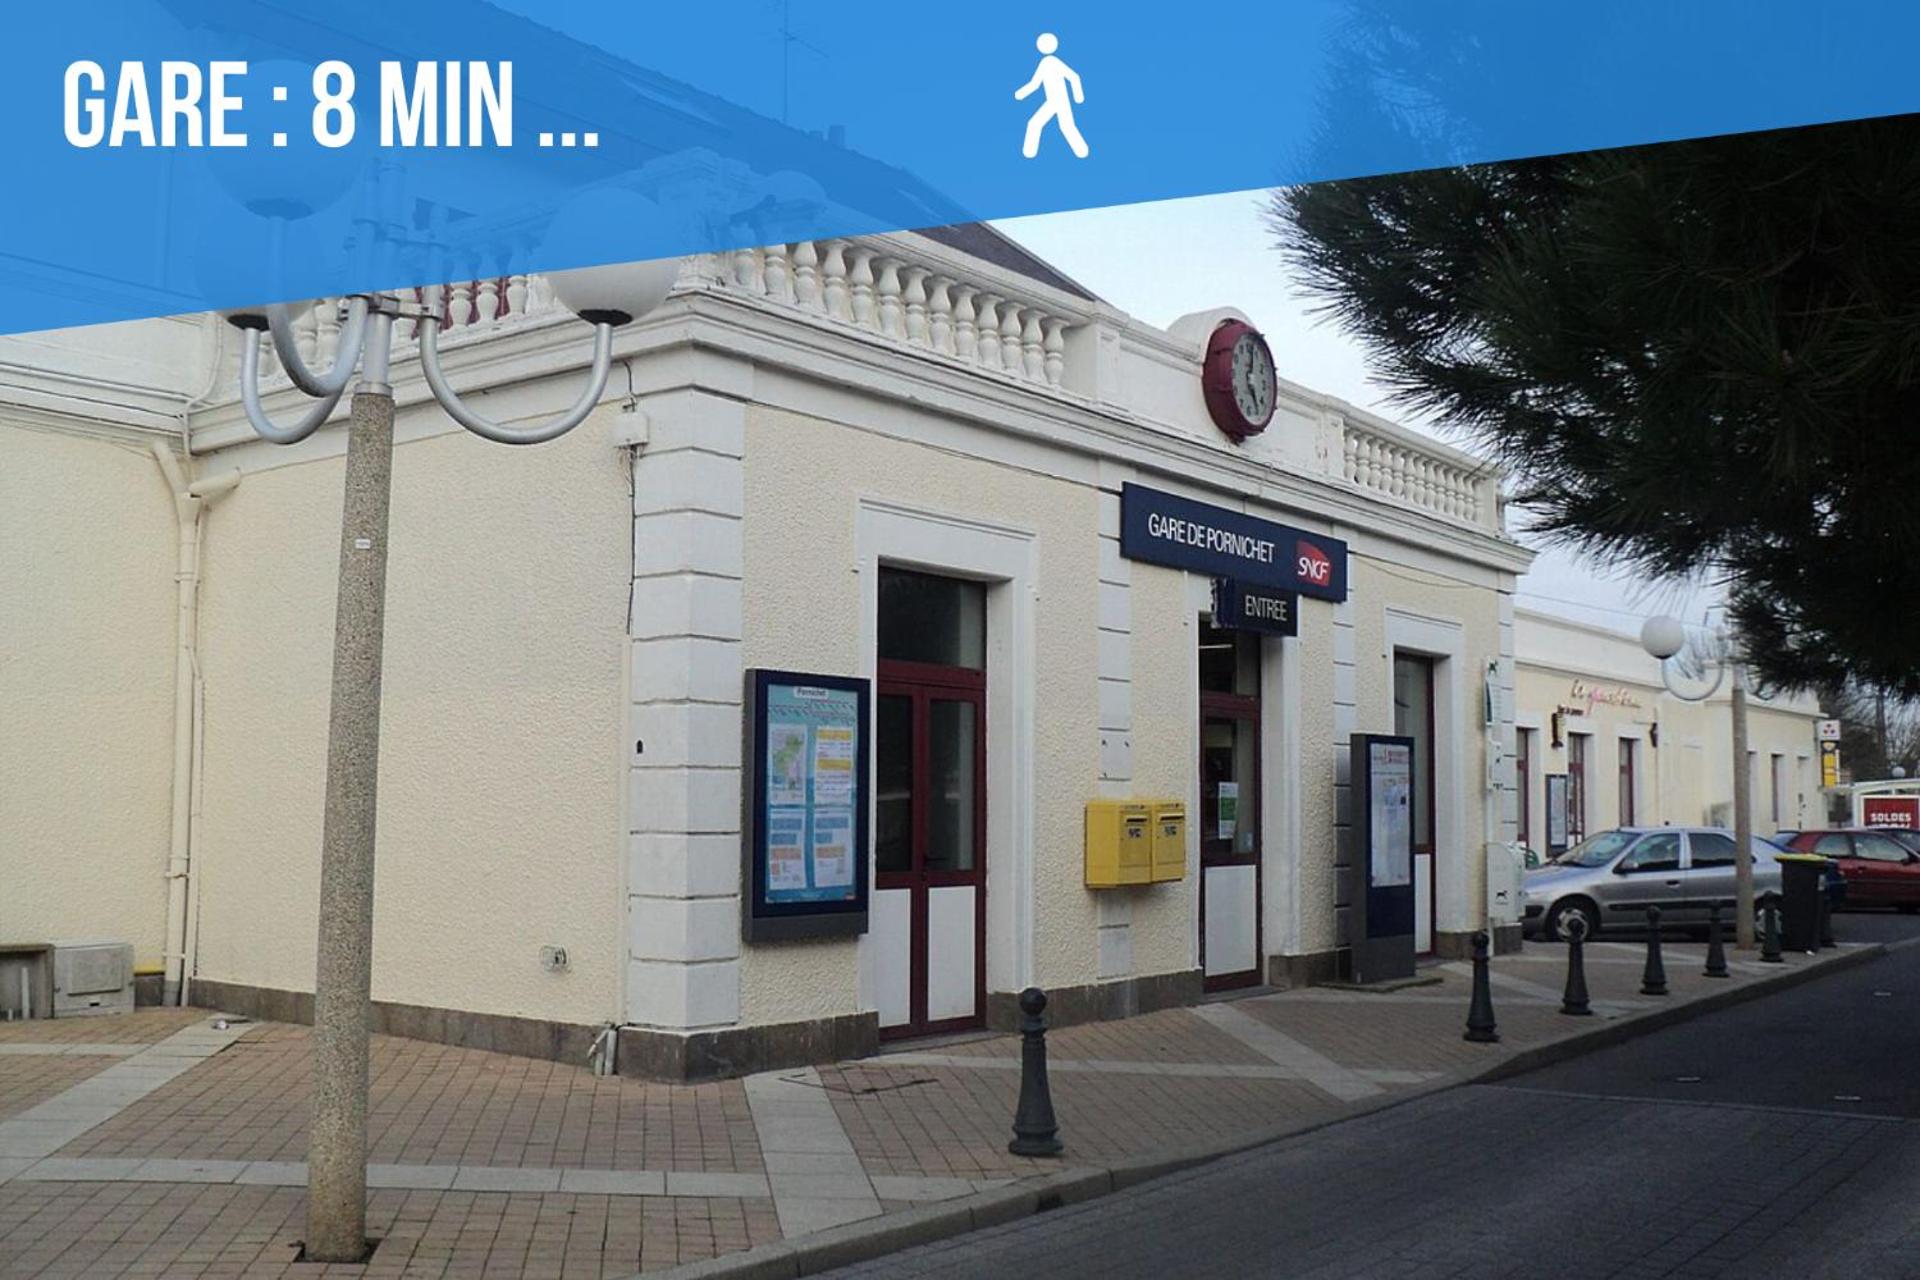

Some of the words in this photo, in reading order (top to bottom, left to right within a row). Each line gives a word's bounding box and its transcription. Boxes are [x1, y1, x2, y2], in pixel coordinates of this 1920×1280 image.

[1148, 512, 1186, 545] GARE
[1187, 523, 1206, 548] DE
[1206, 528, 1275, 564] PORNICHET
[1297, 556, 1331, 581] SNCF
[1870, 812, 1912, 823] SOLDES
